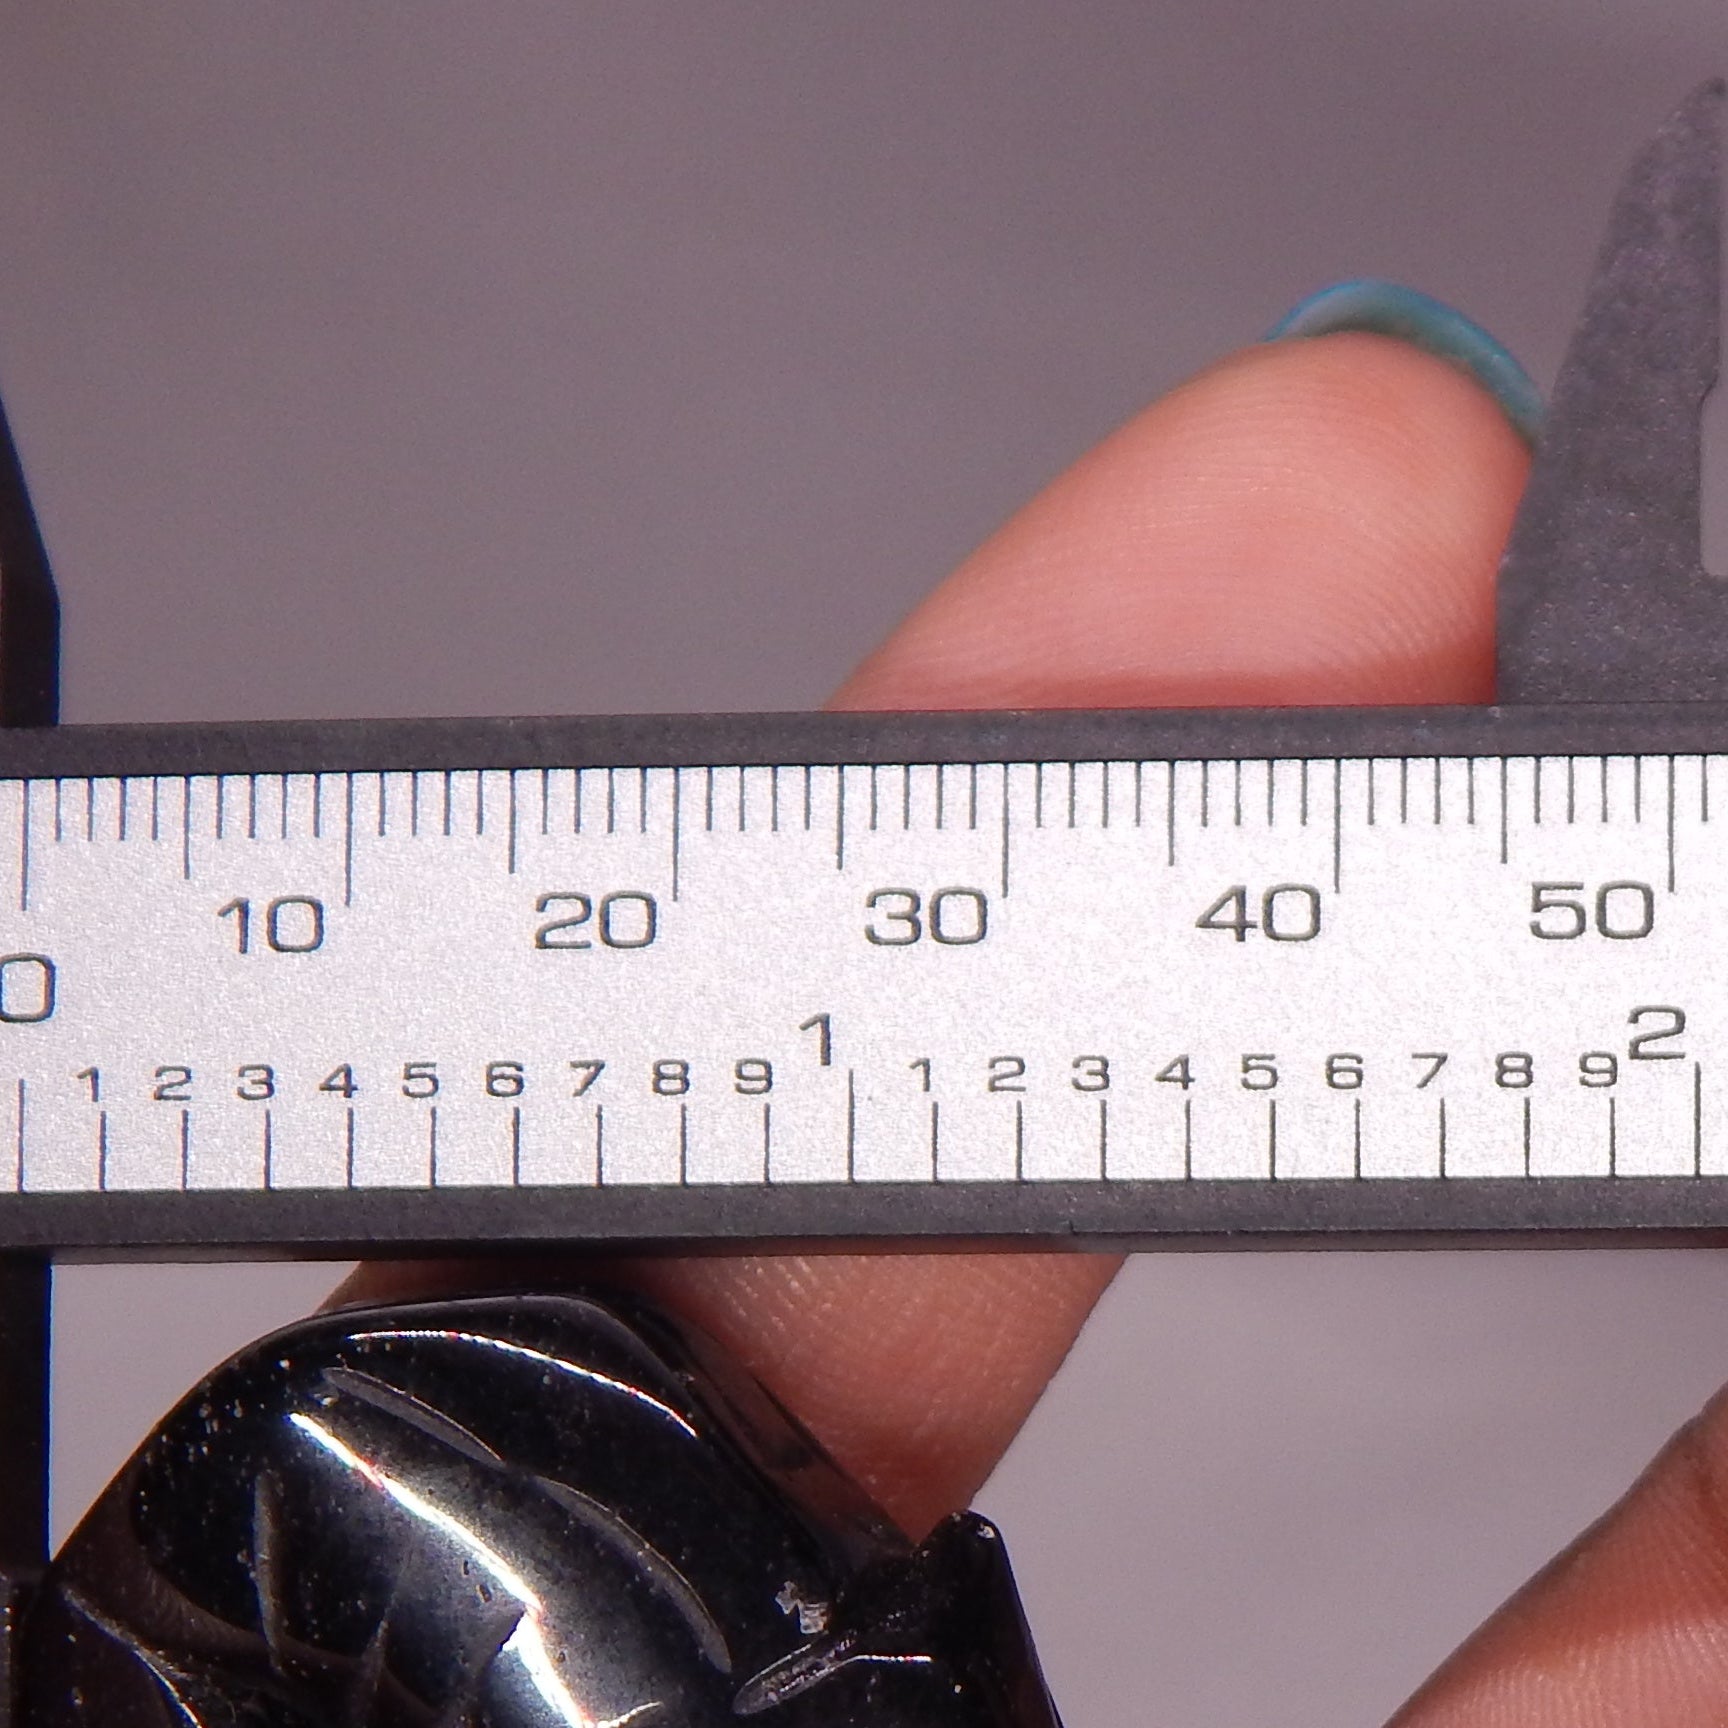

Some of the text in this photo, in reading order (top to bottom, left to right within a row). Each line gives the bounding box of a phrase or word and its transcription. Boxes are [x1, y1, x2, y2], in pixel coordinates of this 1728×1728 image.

[217, 896, 326, 955] 10
[534, 892, 658, 950] 20
[865, 889, 989, 947] 30
[1195, 885, 1322, 942] 40
[1530, 882, 1655, 940] 50
[0, 954, 57, 1024] 0
[78, 1066, 100, 1102] 1
[153, 1066, 192, 1101] 2
[237, 1065, 275, 1100] 3
[319, 1065, 359, 1099] 4
[402, 1062, 440, 1098] 5
[486, 1062, 525, 1097] 6
[570, 1061, 606, 1097] 7
[652, 1060, 691, 1095] 8
[735, 1060, 773, 1095] 9
[799, 1013, 833, 1066] 1
[910, 1058, 932, 1093] 1
[988, 1057, 1027, 1092] 2
[1071, 1057, 1110, 1092] 3
[1156, 1056, 1195, 1090] 4
[1240, 1055, 1279, 1090] 5
[1326, 1055, 1364, 1090] 6
[1411, 1054, 1448, 1089] 7
[1495, 1053, 1534, 1089] 8
[1578, 1053, 1618, 1088] 9
[1628, 1006, 1687, 1061] 2
